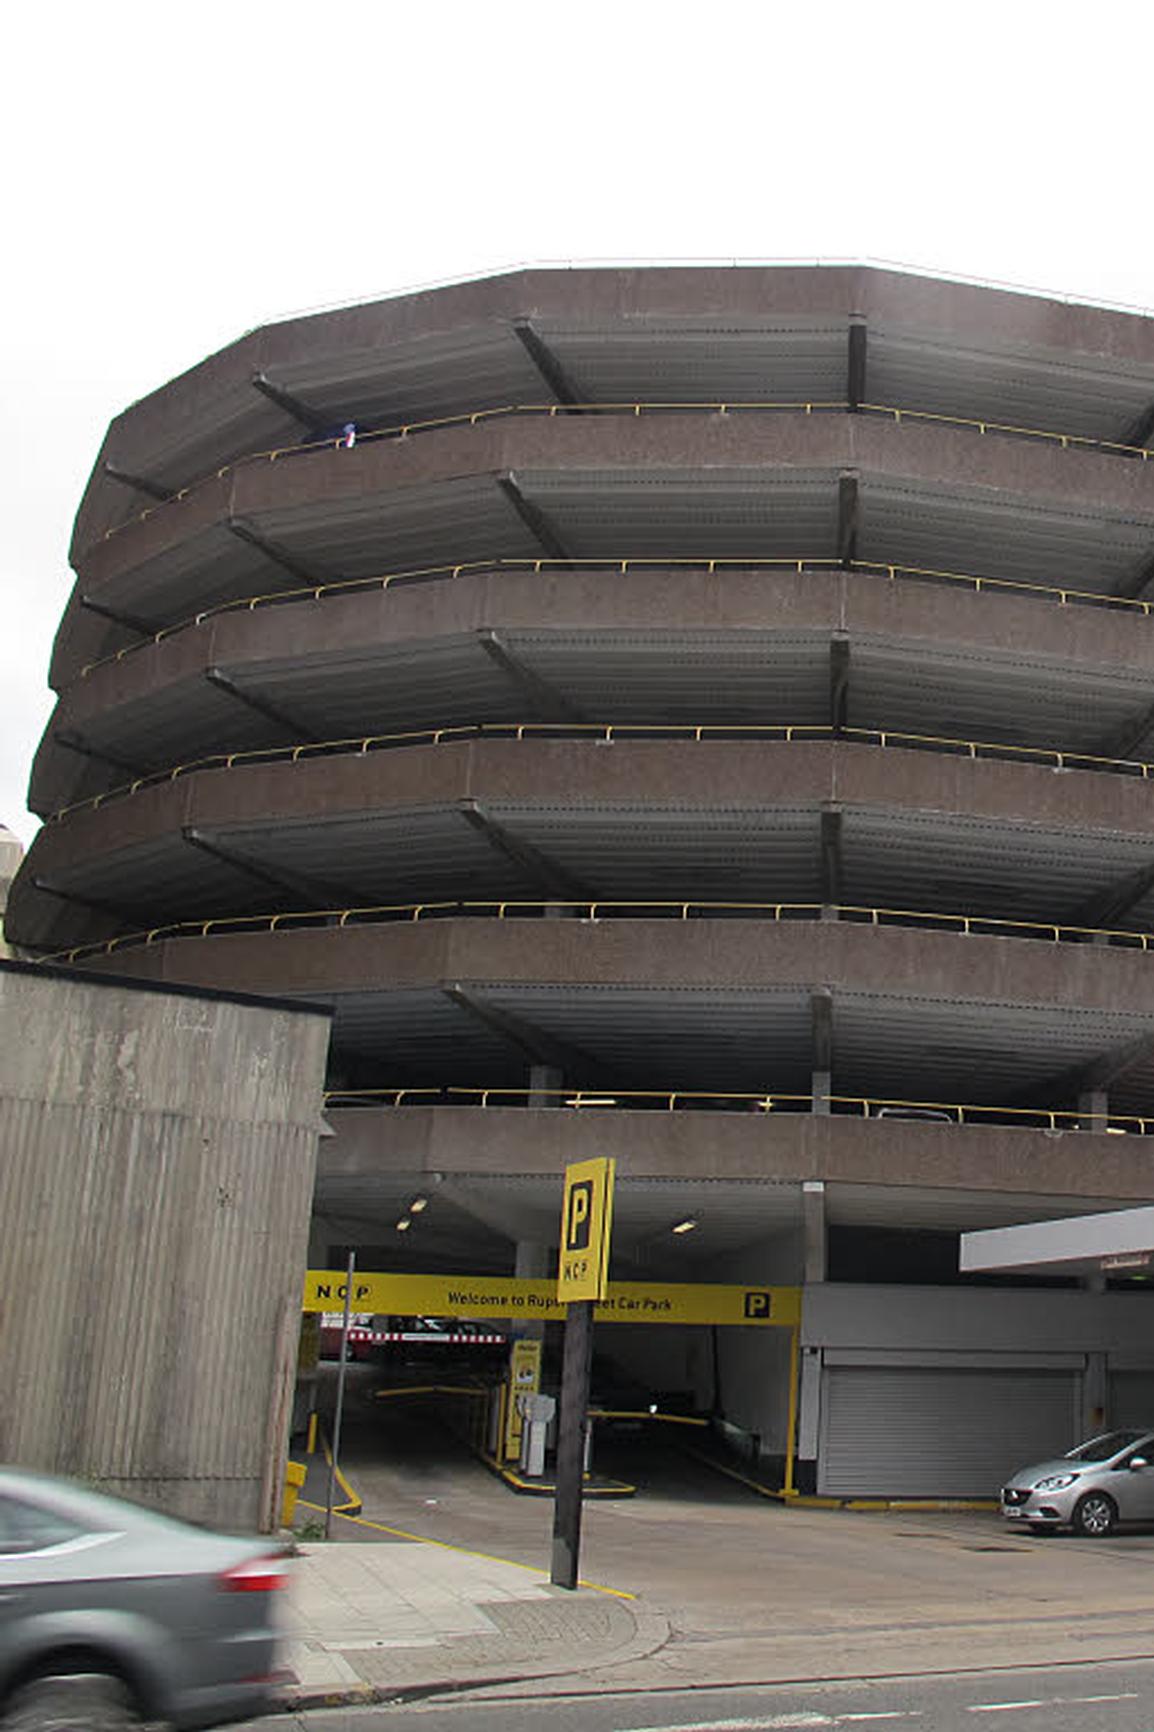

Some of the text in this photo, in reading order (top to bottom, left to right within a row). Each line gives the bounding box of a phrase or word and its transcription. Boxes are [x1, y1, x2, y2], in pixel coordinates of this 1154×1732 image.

[570, 1188, 588, 1244] P
[448, 1292, 508, 1306] Welcome
[512, 1294, 524, 1307] to
[618, 1298, 640, 1311] Car
[643, 1299, 672, 1311] Park
[749, 1295, 766, 1316] P
